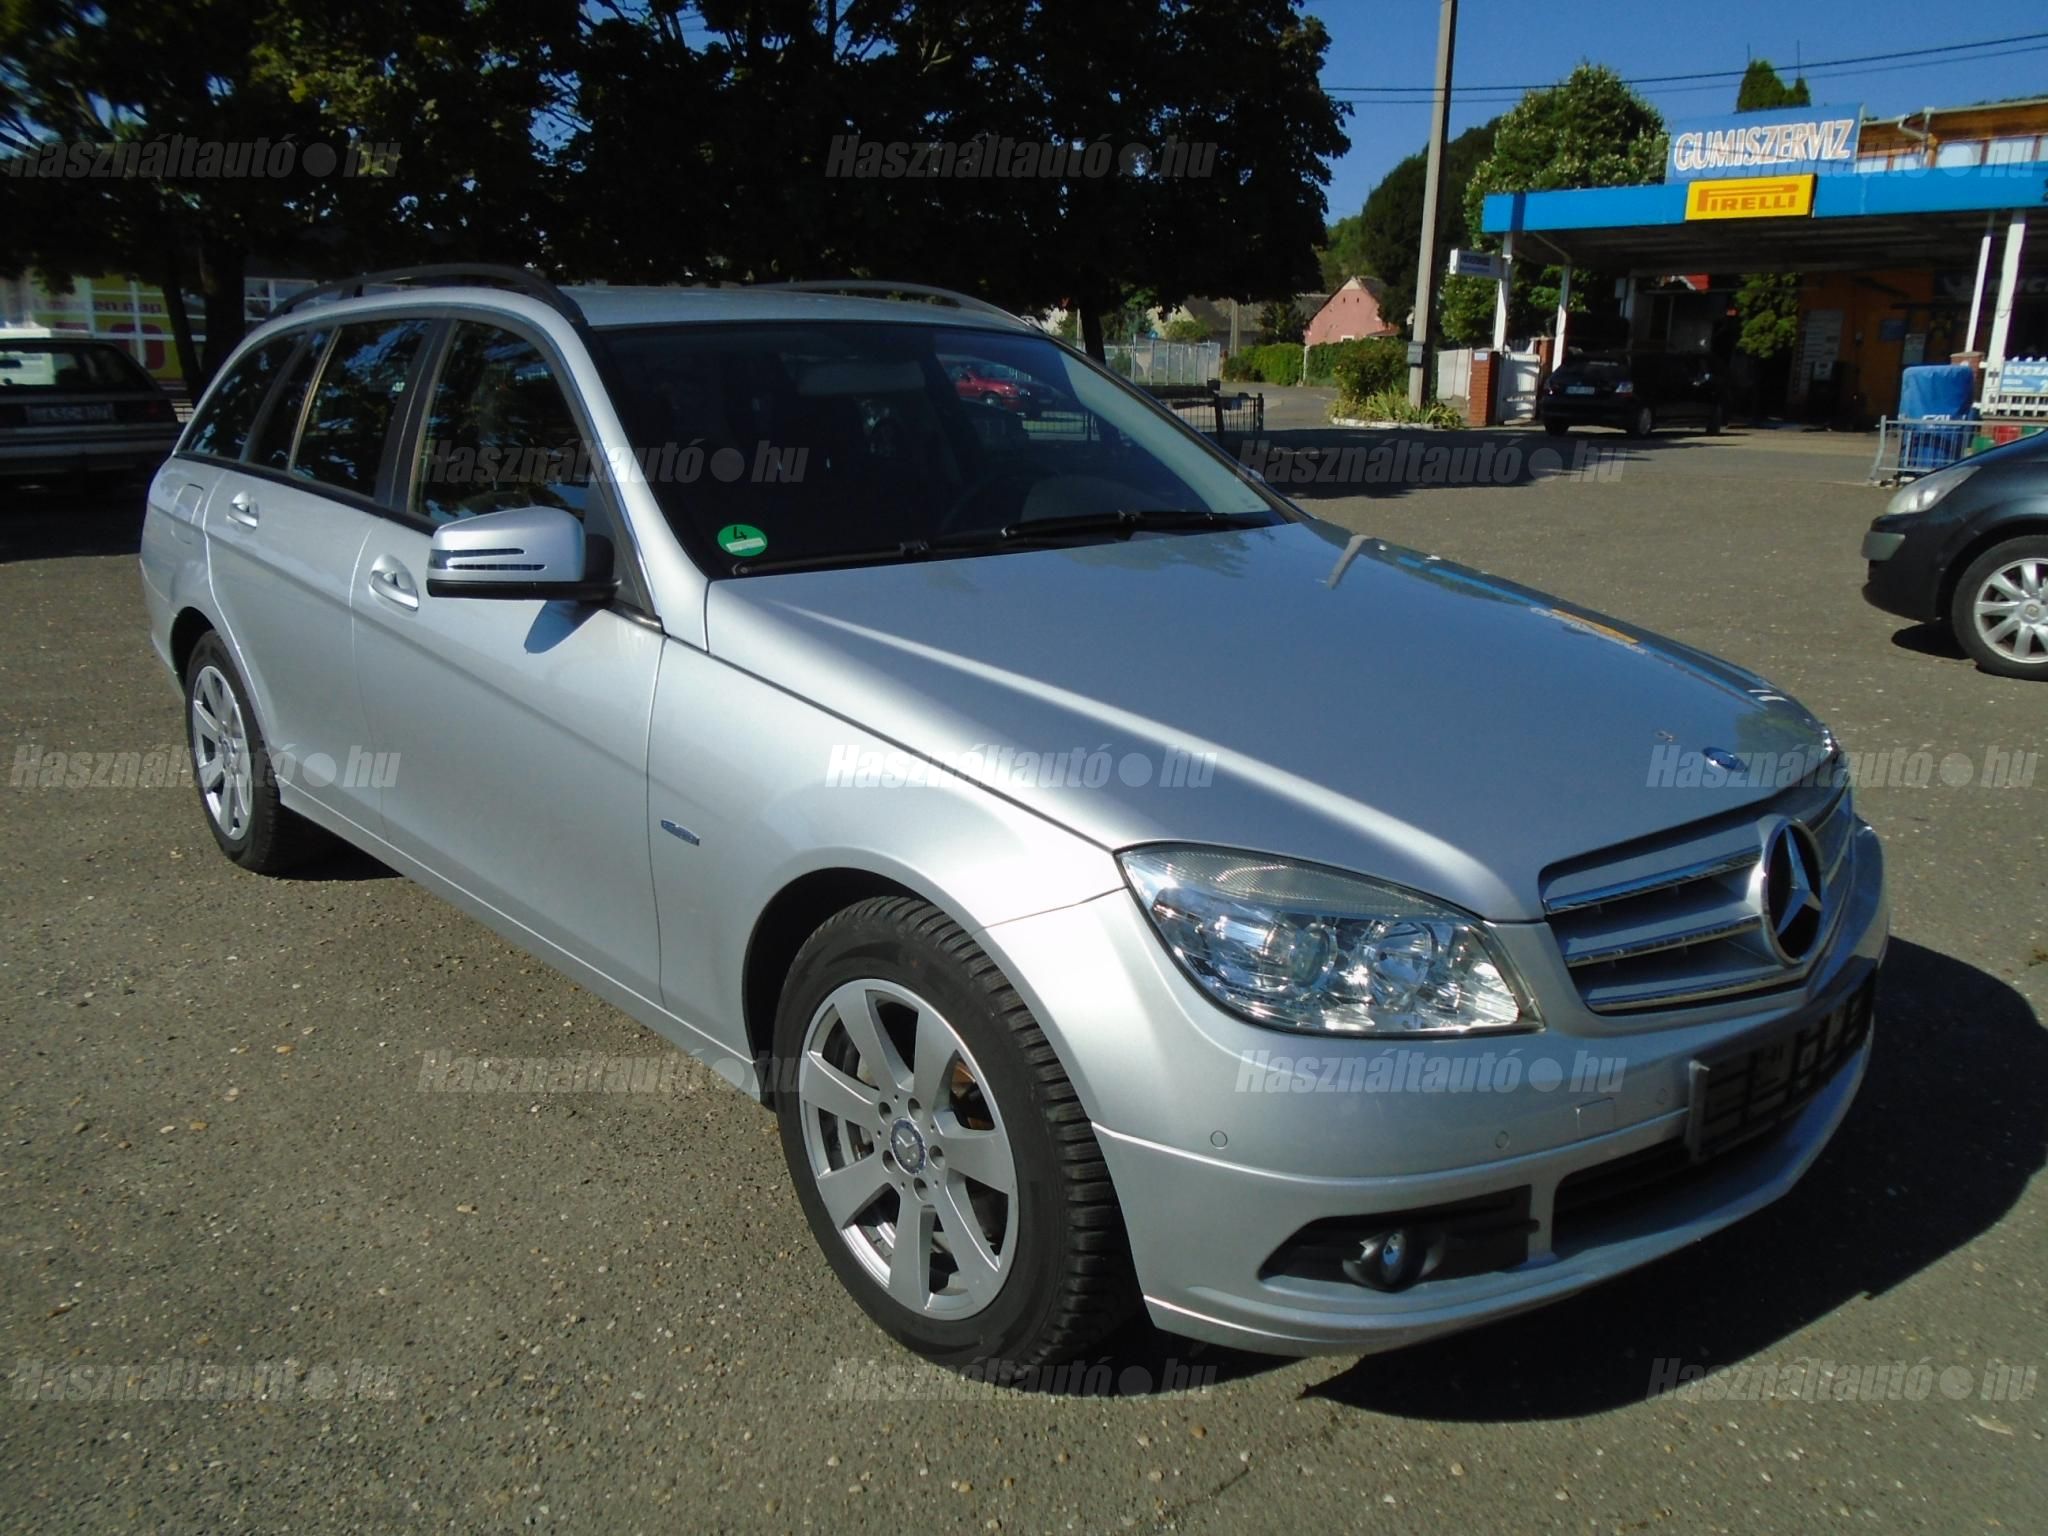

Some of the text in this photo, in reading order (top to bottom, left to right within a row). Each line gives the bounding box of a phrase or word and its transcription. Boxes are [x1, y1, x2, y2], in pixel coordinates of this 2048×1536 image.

[1672, 119, 1854, 172] GUMISZERVIZ
[1696, 183, 1800, 213] PIRELLI
[733, 526, 748, 540] 4
